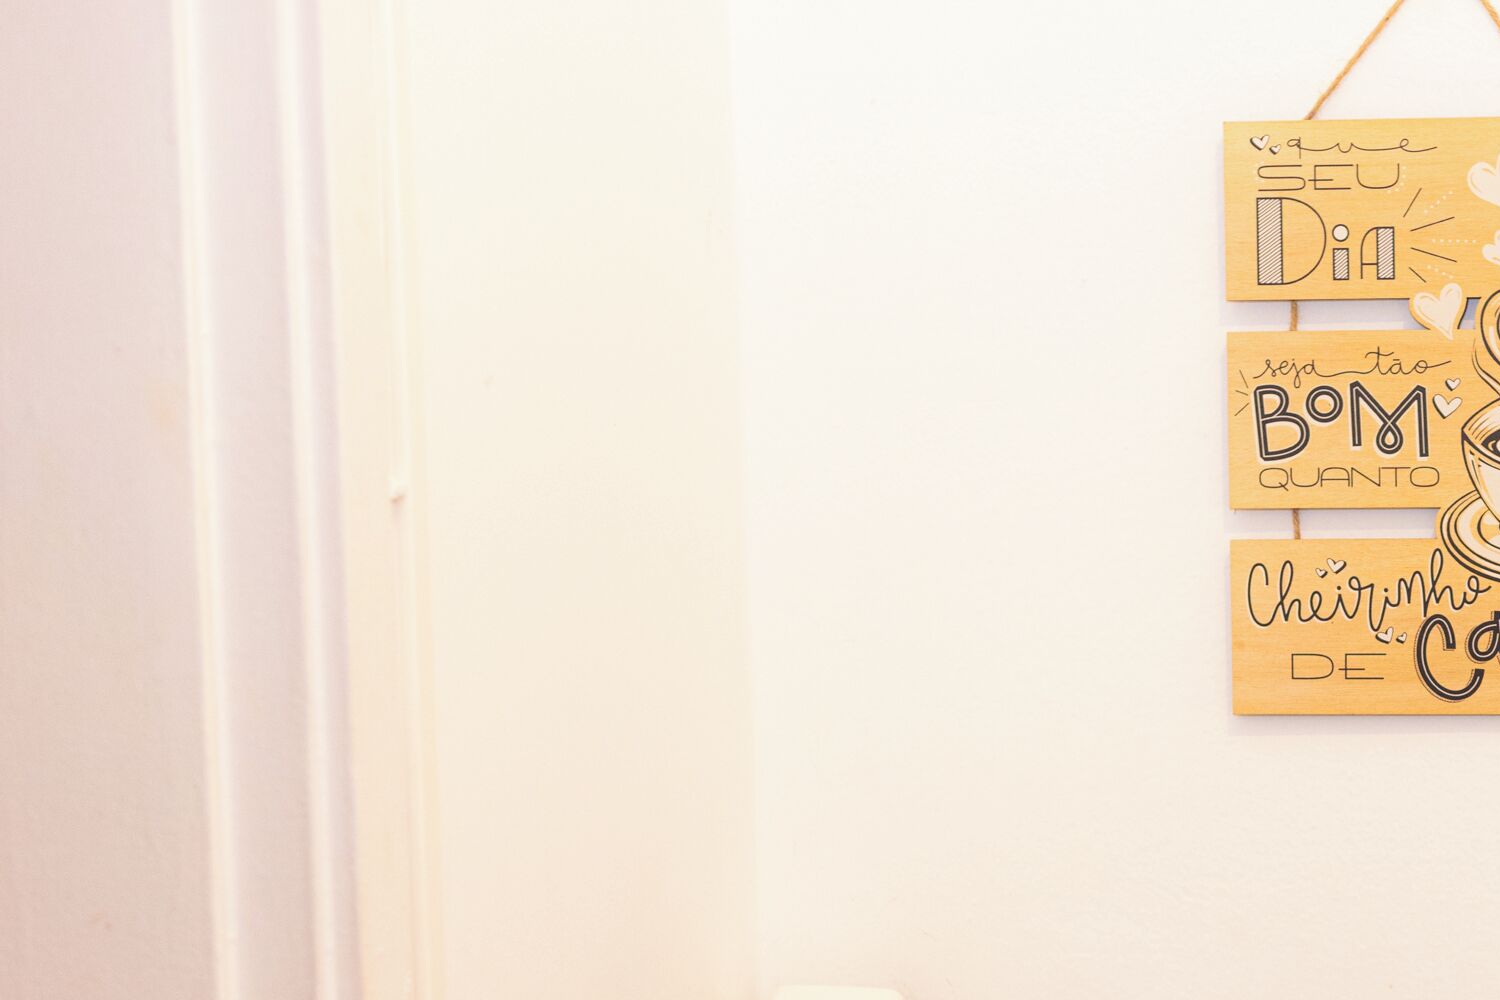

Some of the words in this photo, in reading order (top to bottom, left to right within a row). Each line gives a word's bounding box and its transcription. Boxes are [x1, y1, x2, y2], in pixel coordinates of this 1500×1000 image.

[1287, 135, 1438, 159] que
[1257, 162, 1401, 191] SEU
[1253, 357, 1322, 389] seja
[1363, 346, 1451, 377] tão
[1258, 466, 1440, 492] QUANTO
[1247, 548, 1492, 632] Cheirinho
[1290, 653, 1387, 680] DE
